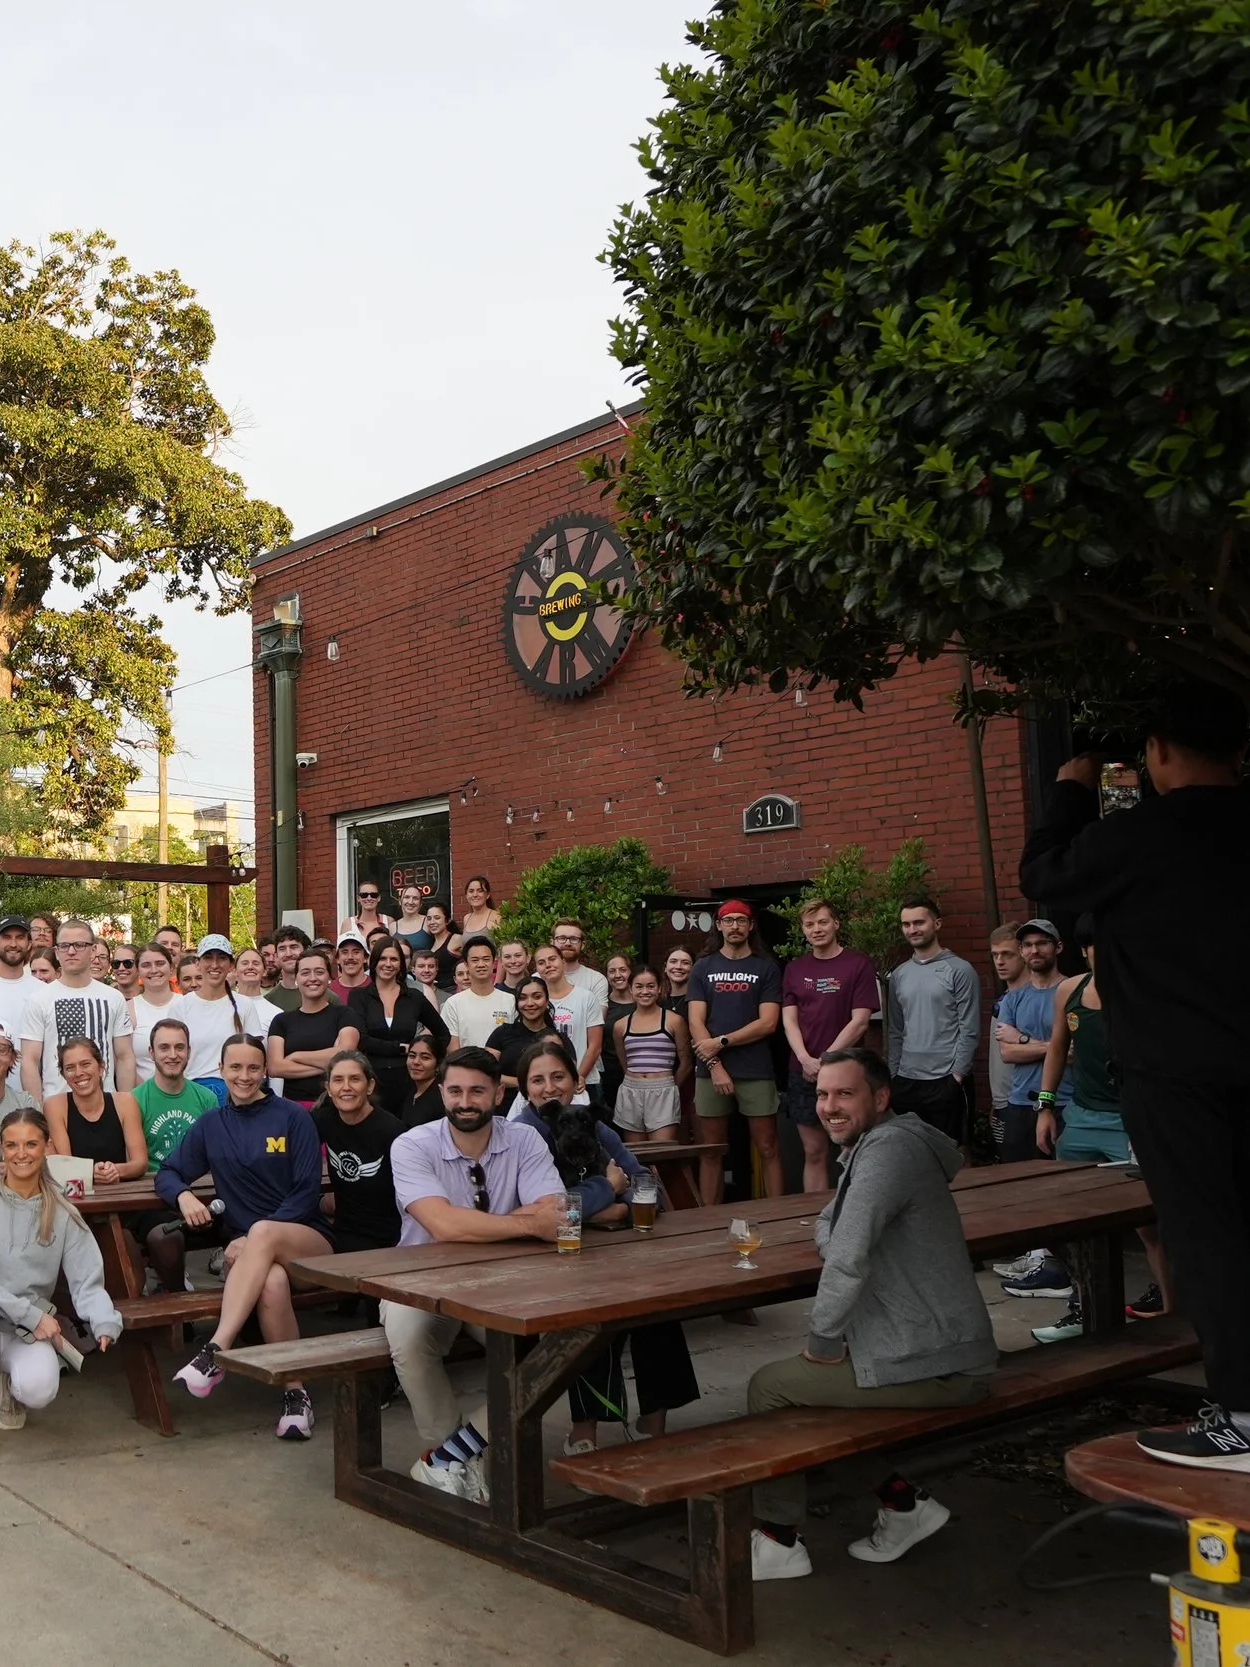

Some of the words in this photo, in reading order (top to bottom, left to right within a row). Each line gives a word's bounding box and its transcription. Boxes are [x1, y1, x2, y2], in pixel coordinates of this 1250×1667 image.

[539, 593, 582, 617] BREWING
[755, 803, 784, 827] 319
[392, 865, 436, 887] BEER
[707, 972, 759, 984] TWILIGHT
[714, 982, 749, 993] 5000
[150, 1109, 183, 1135] HIGHLAND
[266, 1136, 286, 1153] M
[1205, 1428, 1250, 1452] N
